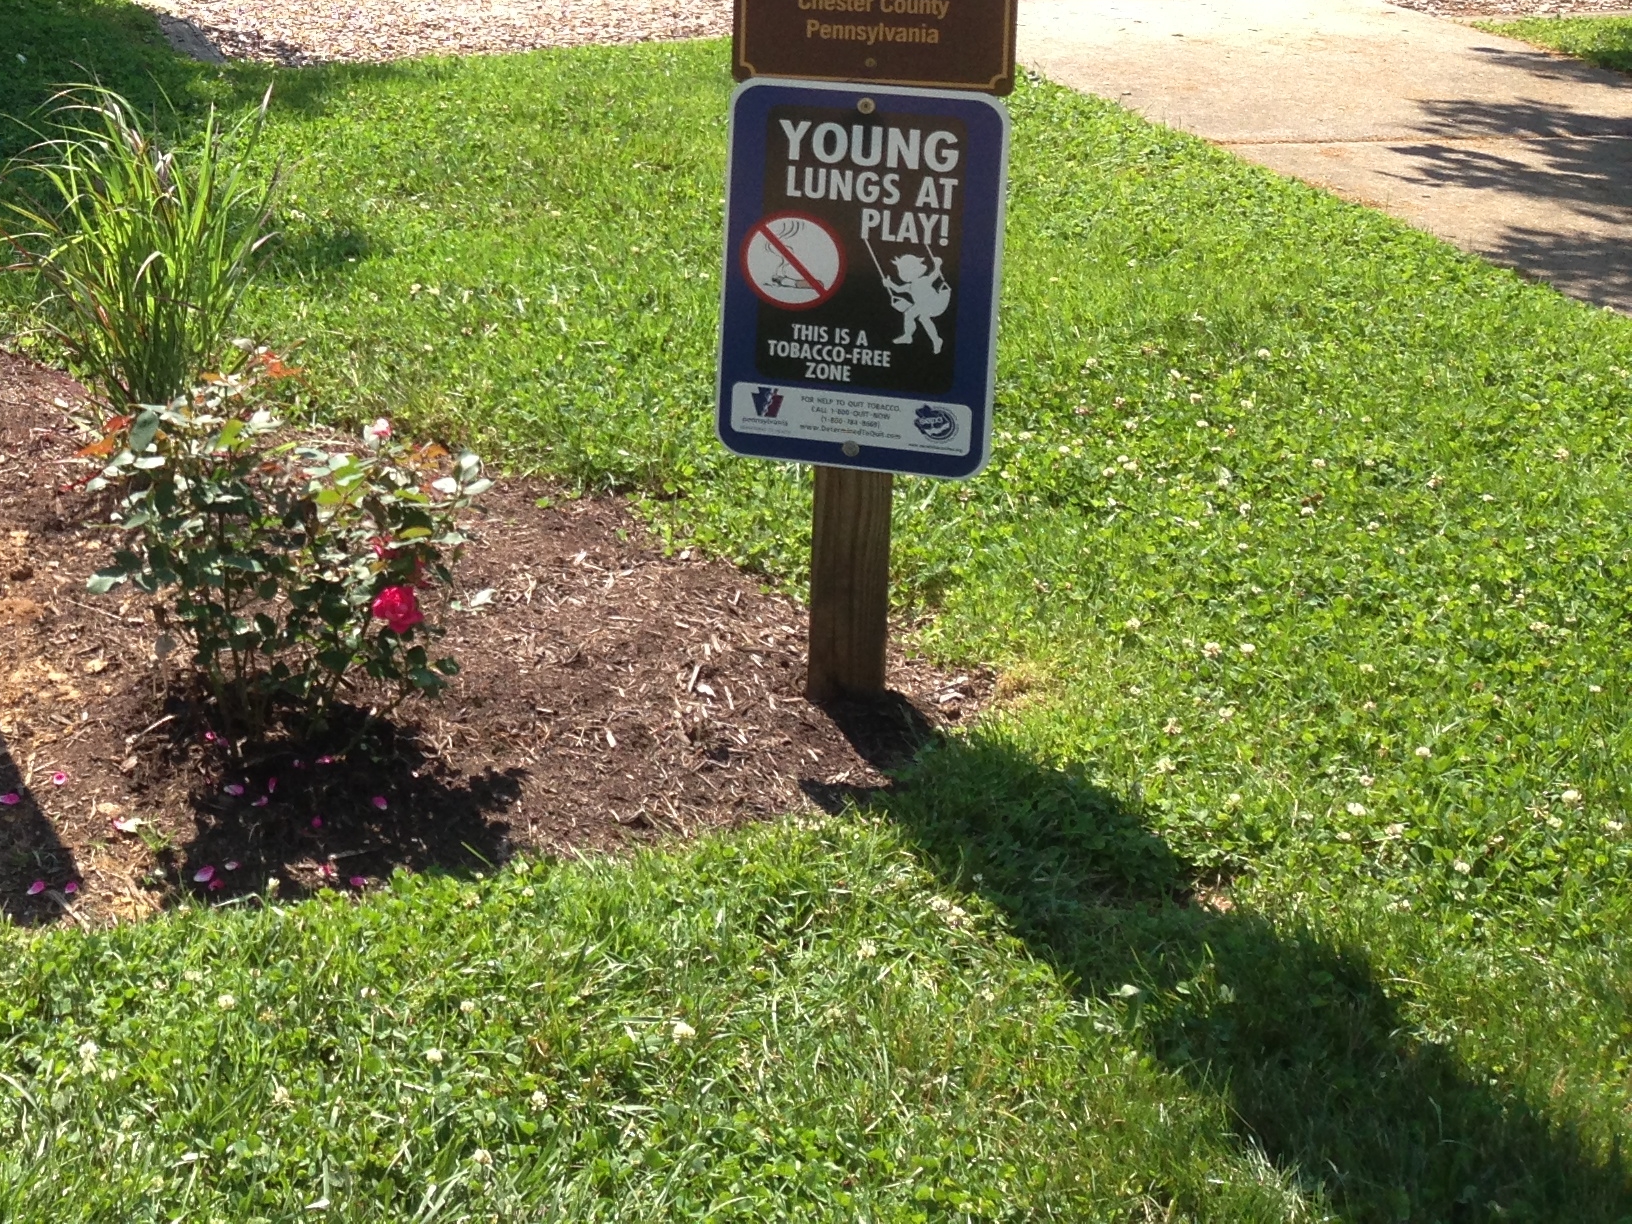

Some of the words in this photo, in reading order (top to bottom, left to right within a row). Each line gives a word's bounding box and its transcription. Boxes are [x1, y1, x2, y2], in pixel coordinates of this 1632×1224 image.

[806, 19, 939, 44] Pennsylvania
[779, 119, 959, 172] YOUNG
[786, 165, 900, 205] LUNGS
[916, 178, 958, 210] AT
[861, 208, 949, 246] PLAY!
[792, 323, 828, 342] THIS
[835, 327, 851, 344] IS
[856, 330, 868, 346] A
[768, 340, 891, 367] TOBACCO-FREE
[806, 363, 851, 382] ZONE
[812, 406, 827, 414] CALL
